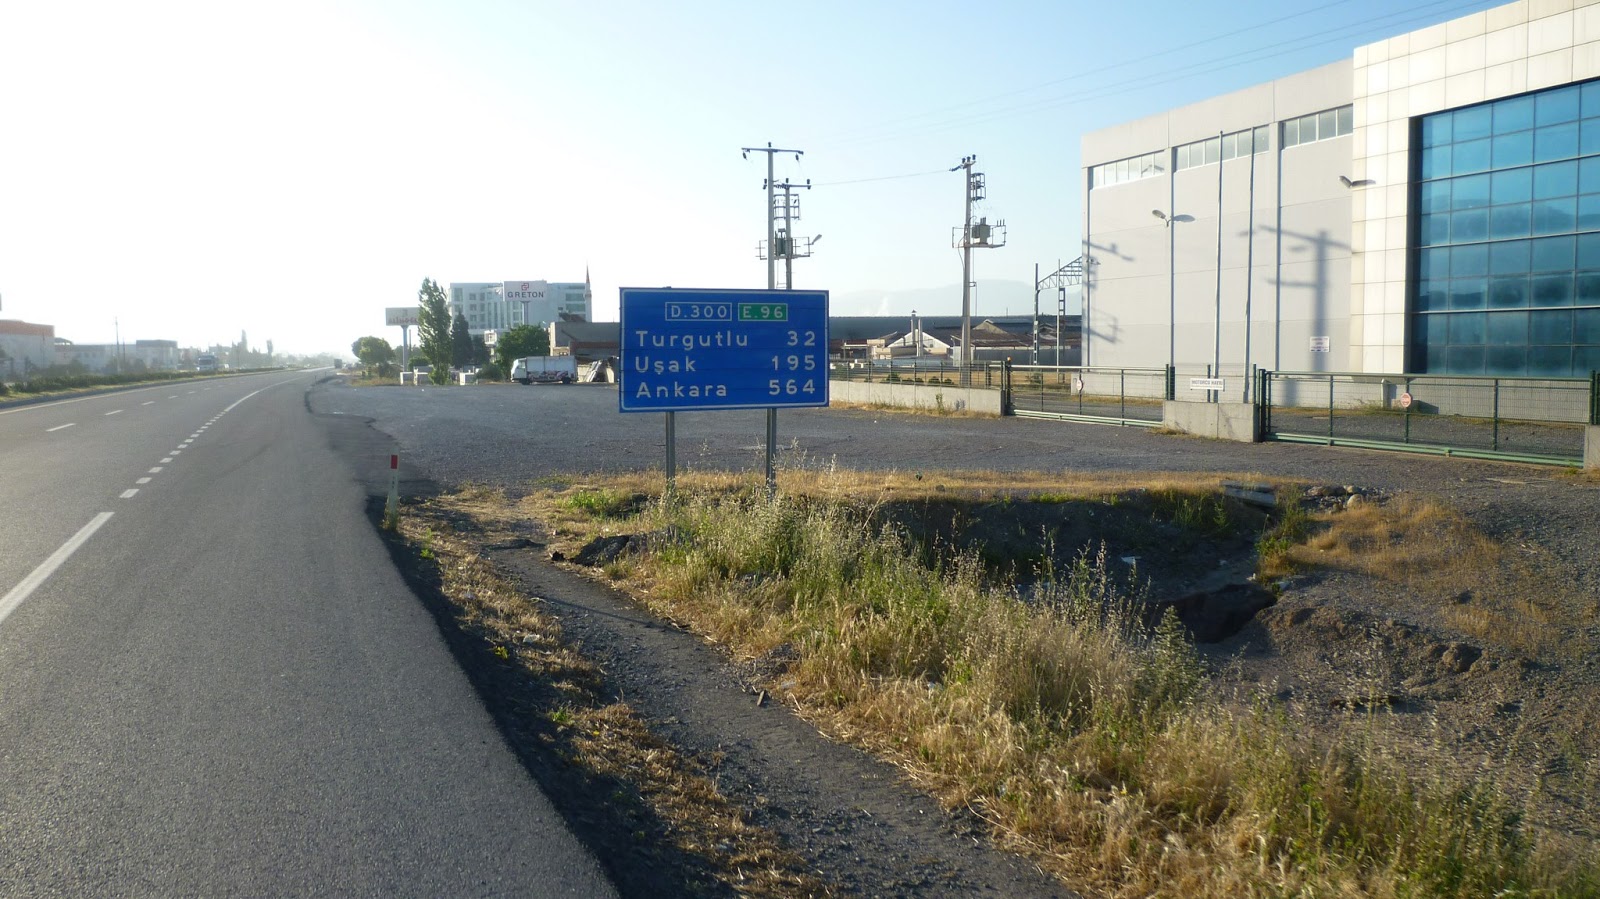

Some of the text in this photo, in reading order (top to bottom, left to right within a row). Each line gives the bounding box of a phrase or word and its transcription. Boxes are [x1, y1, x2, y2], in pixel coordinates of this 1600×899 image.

[671, 305, 784, 318] D.300 E.96
[635, 330, 816, 350] Turgutlu 32
[635, 355, 816, 374] Uşak 195
[636, 379, 816, 398] Ankara 564
